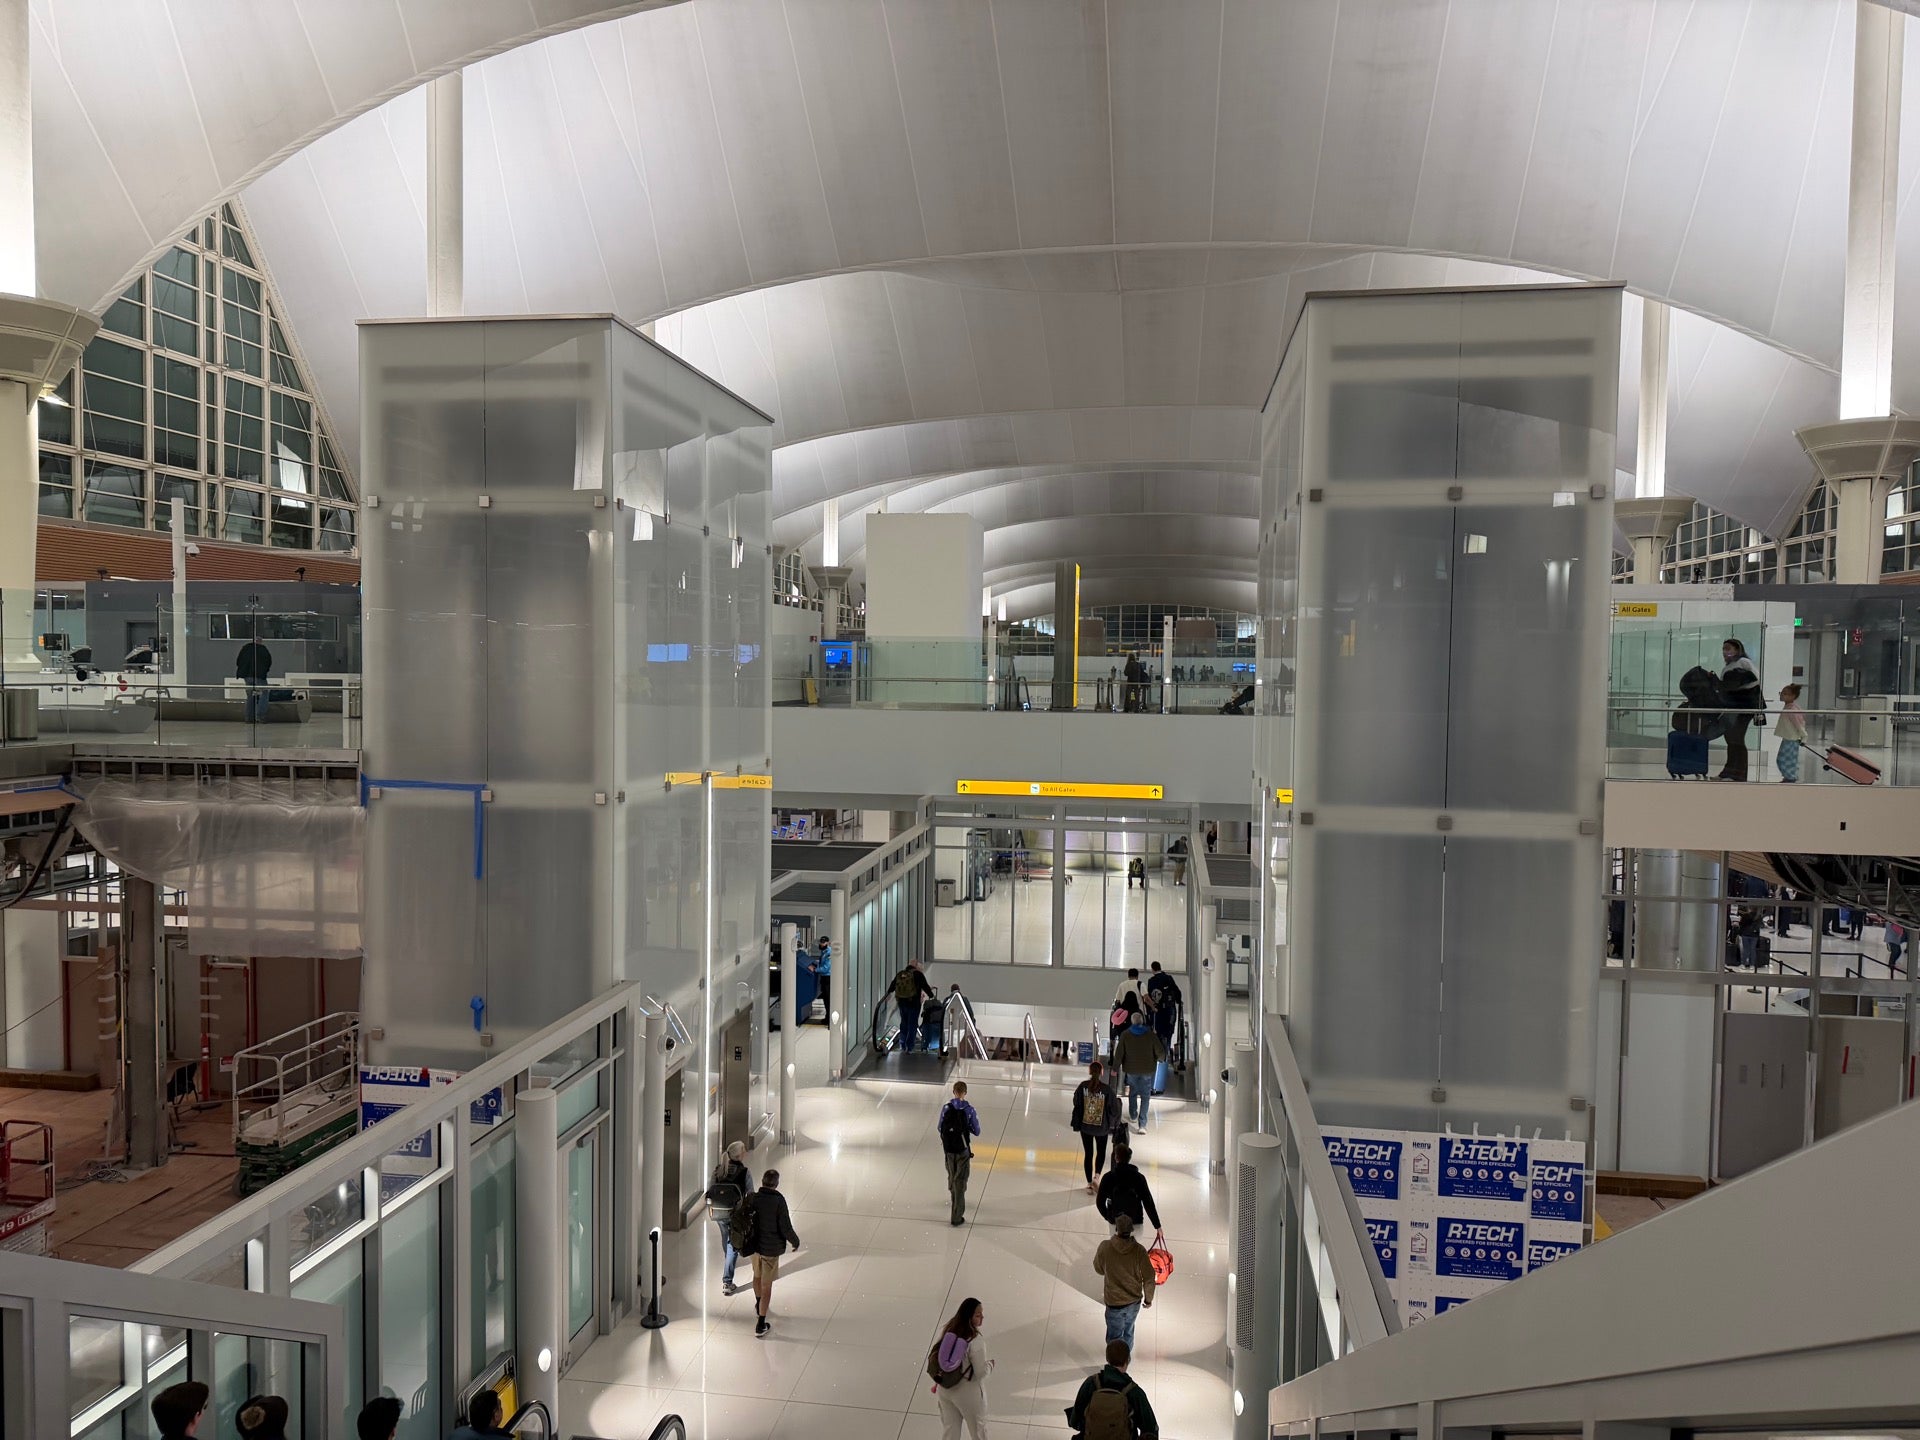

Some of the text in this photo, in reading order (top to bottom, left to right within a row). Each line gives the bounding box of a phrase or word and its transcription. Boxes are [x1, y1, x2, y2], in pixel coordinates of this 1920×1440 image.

[1412, 1141, 1431, 1150] Henry
[1450, 1143, 1518, 1162] R-TECH
[1488, 1160, 1517, 1168] EFFICIENCY
[1410, 1220, 1429, 1229] Henry
[1447, 1223, 1515, 1242] R-TECH
[1486, 1240, 1514, 1248] EFFICIENCY
[1408, 1299, 1428, 1308] Henry
